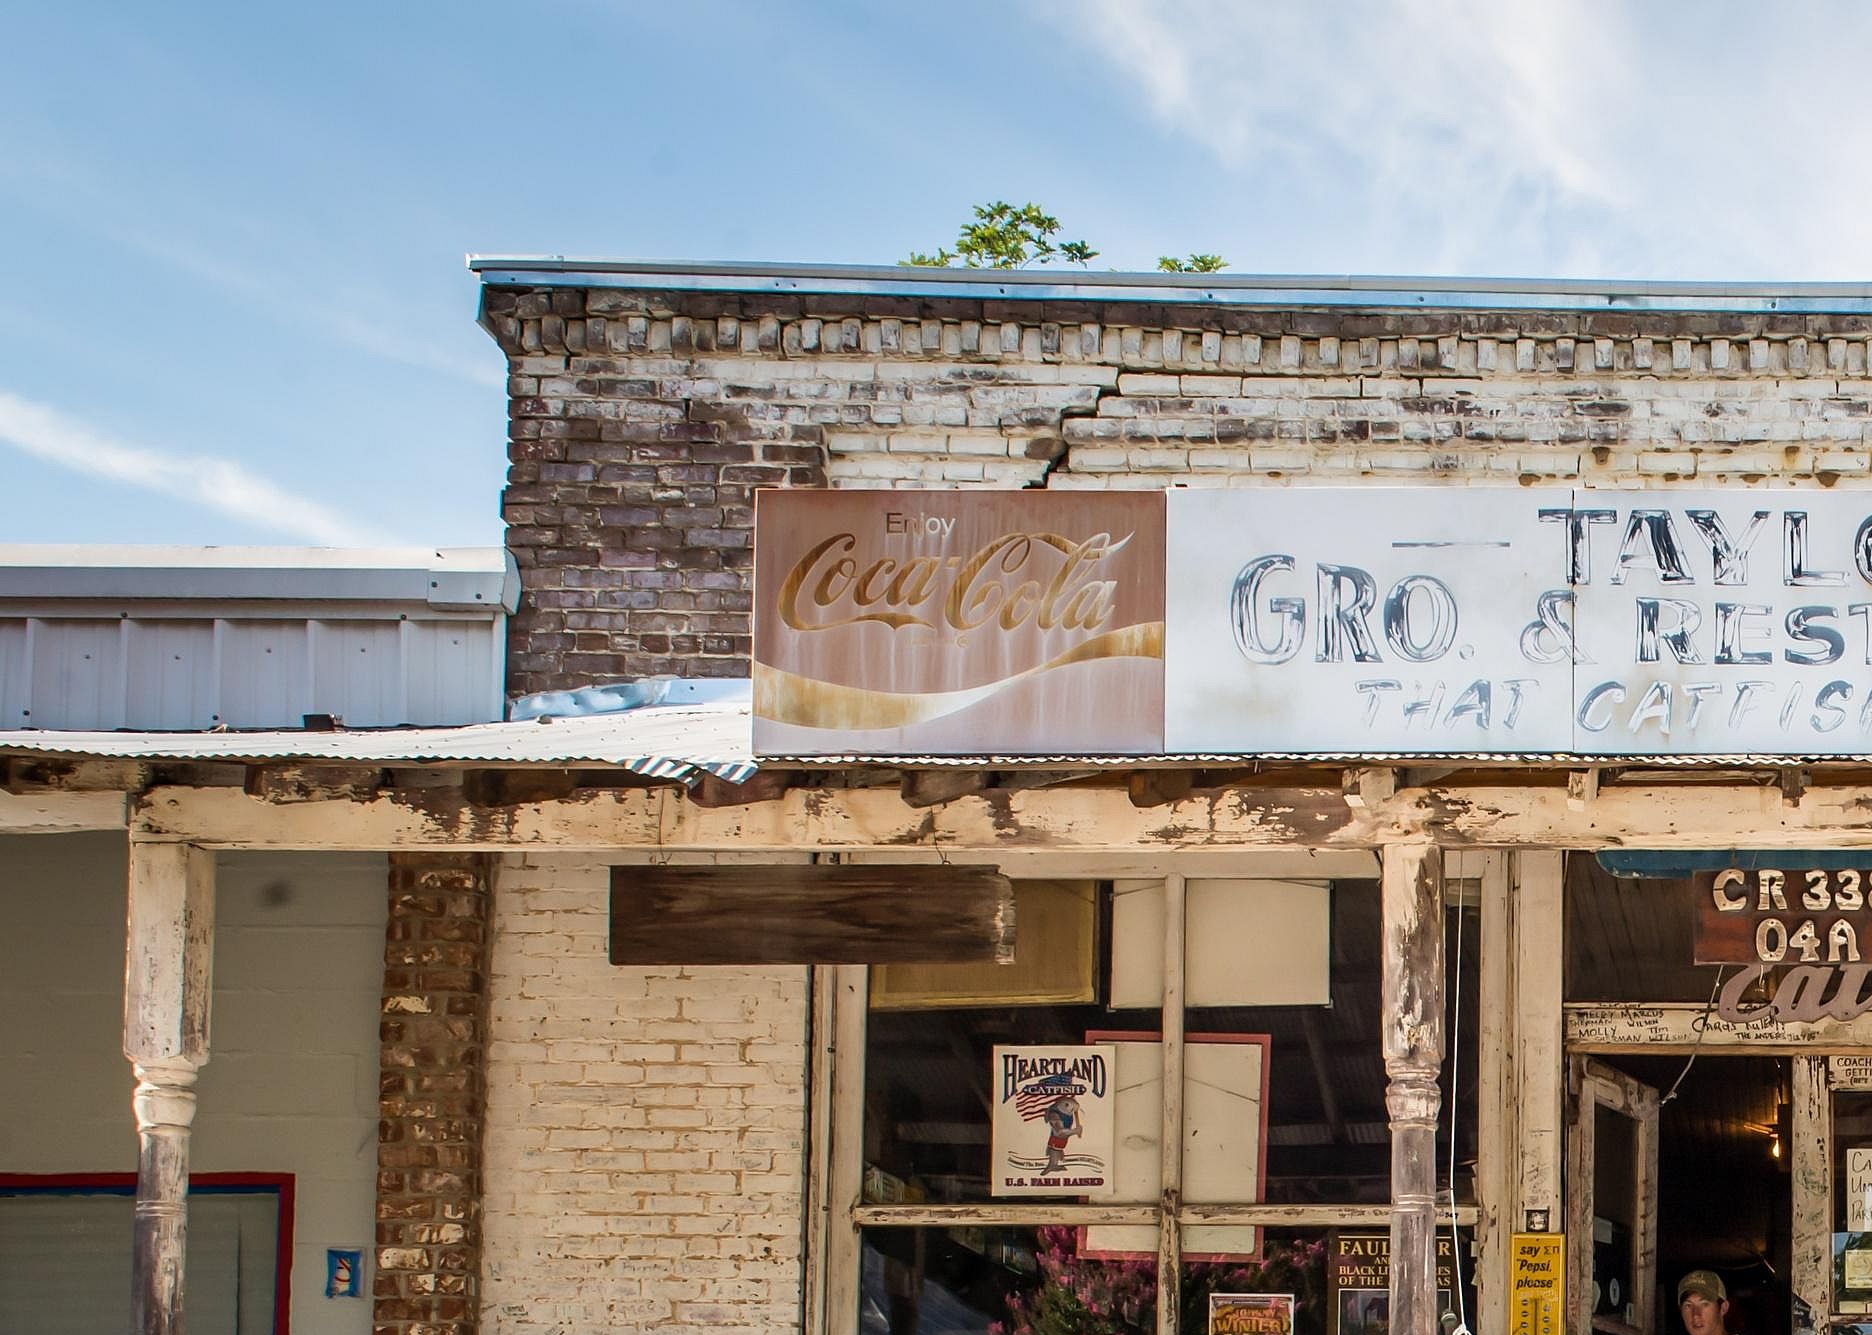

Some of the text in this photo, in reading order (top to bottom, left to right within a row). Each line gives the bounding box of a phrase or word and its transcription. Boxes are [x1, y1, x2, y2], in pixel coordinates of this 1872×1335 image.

[885, 511, 956, 538] Enjoy
[779, 530, 1135, 633] Coca-Cola
[1231, 554, 1477, 665] GRO.
[1518, 589, 1600, 667] &
[1354, 679, 1542, 731] THAT
[1578, 1026, 1617, 1038] MOLLY
[1836, 1057, 1872, 1067] COACH
[1002, 1054, 1107, 1105] HEARTLAND
[1028, 1085, 1081, 1095] CATFISH
[1005, 1177, 1105, 1187] U.S. FARM RAISED
[1339, 1240, 1452, 1256] FAULR
[1519, 1245, 1541, 1258] say
[1339, 1265, 1375, 1276] BLACK
[1339, 1276, 1384, 1286] OF THE
[1214, 1317, 1284, 1334] WINTER
